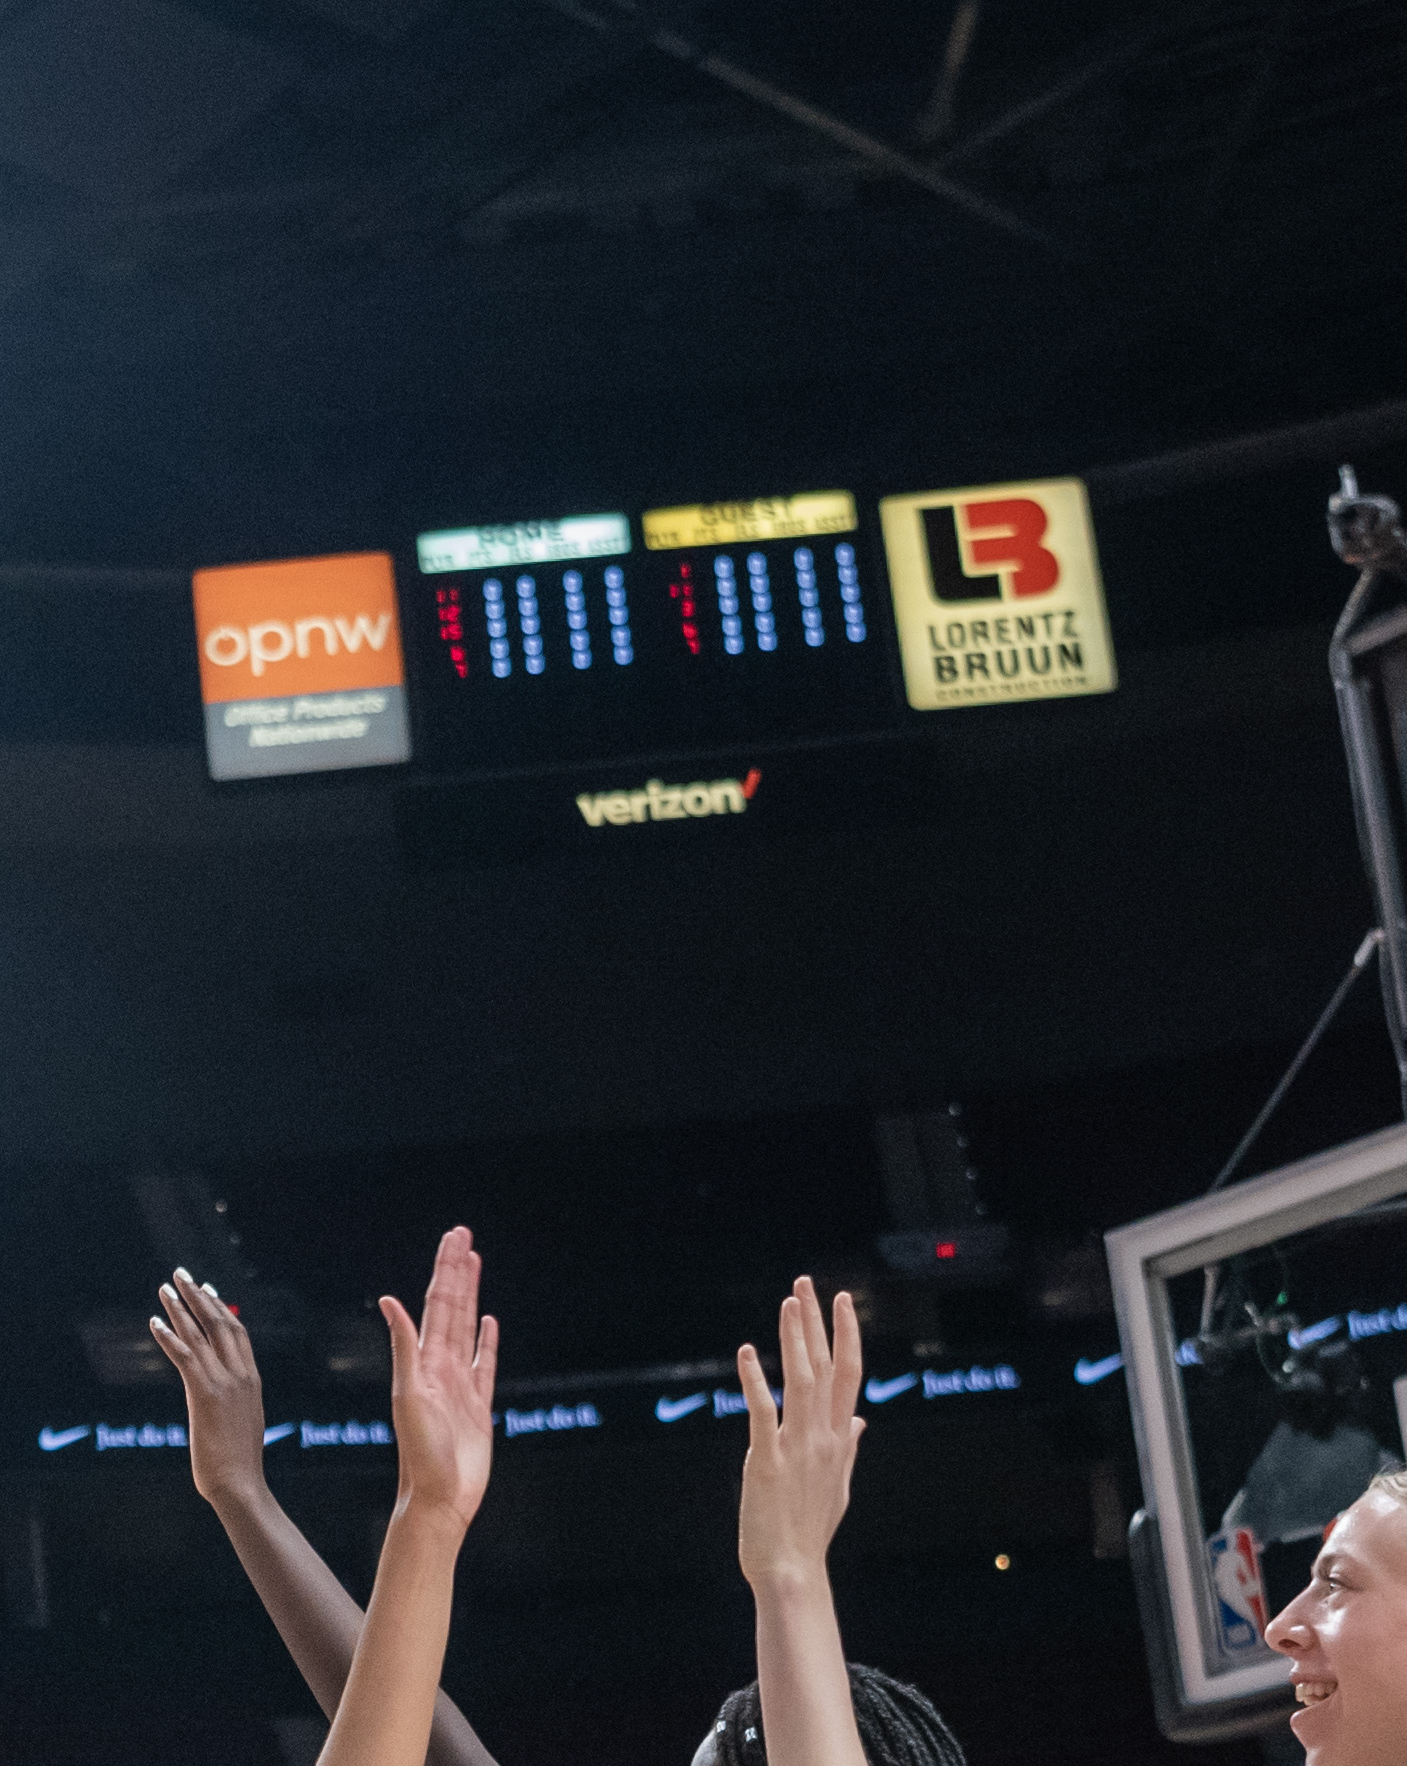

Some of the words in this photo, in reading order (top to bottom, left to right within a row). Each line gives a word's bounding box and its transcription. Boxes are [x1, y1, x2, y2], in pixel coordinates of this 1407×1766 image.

[477, 521, 565, 548] HOME
[698, 503, 793, 527] GUEST
[204, 611, 392, 677] opnw
[927, 610, 1079, 651] LORENTZ
[932, 642, 1085, 684] BRUUN
[576, 776, 746, 828] verizon
